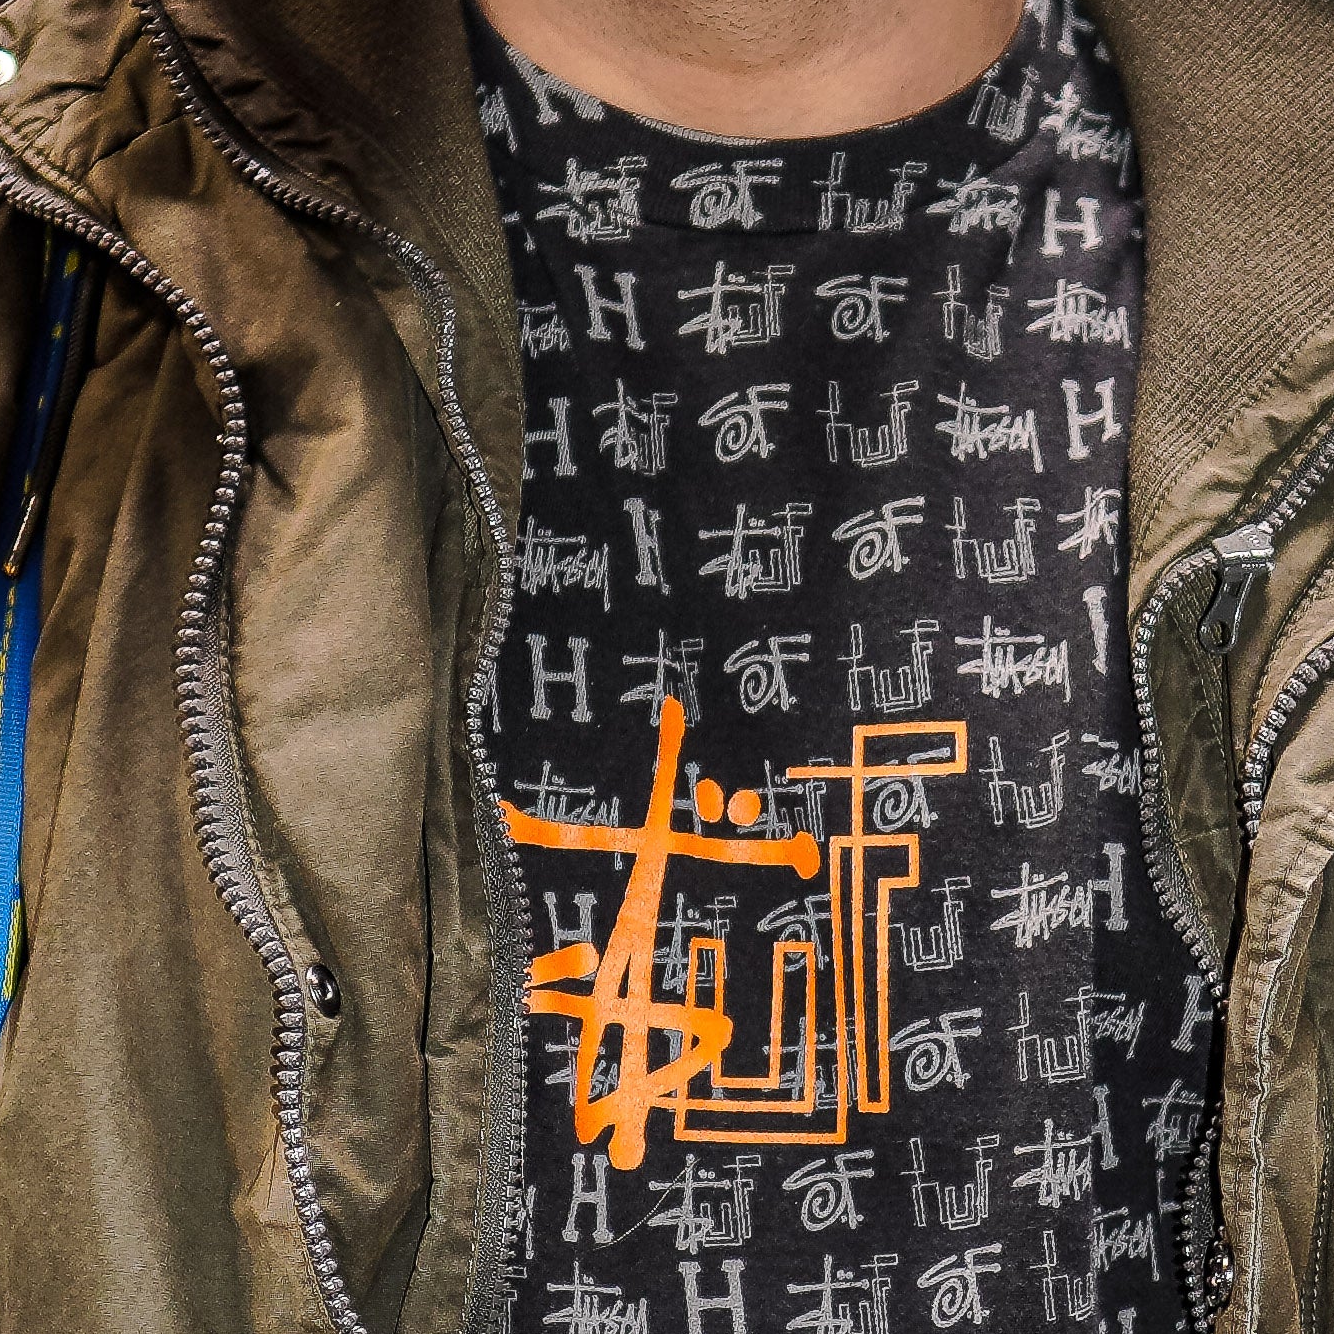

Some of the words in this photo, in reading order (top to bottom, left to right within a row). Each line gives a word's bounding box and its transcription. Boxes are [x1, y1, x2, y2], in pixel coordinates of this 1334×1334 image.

[1039, 189, 1103, 259] H
[575, 264, 645, 351] H
[1061, 376, 1122, 460] H
[525, 633, 591, 722] H
[563, 1153, 614, 1242] H
